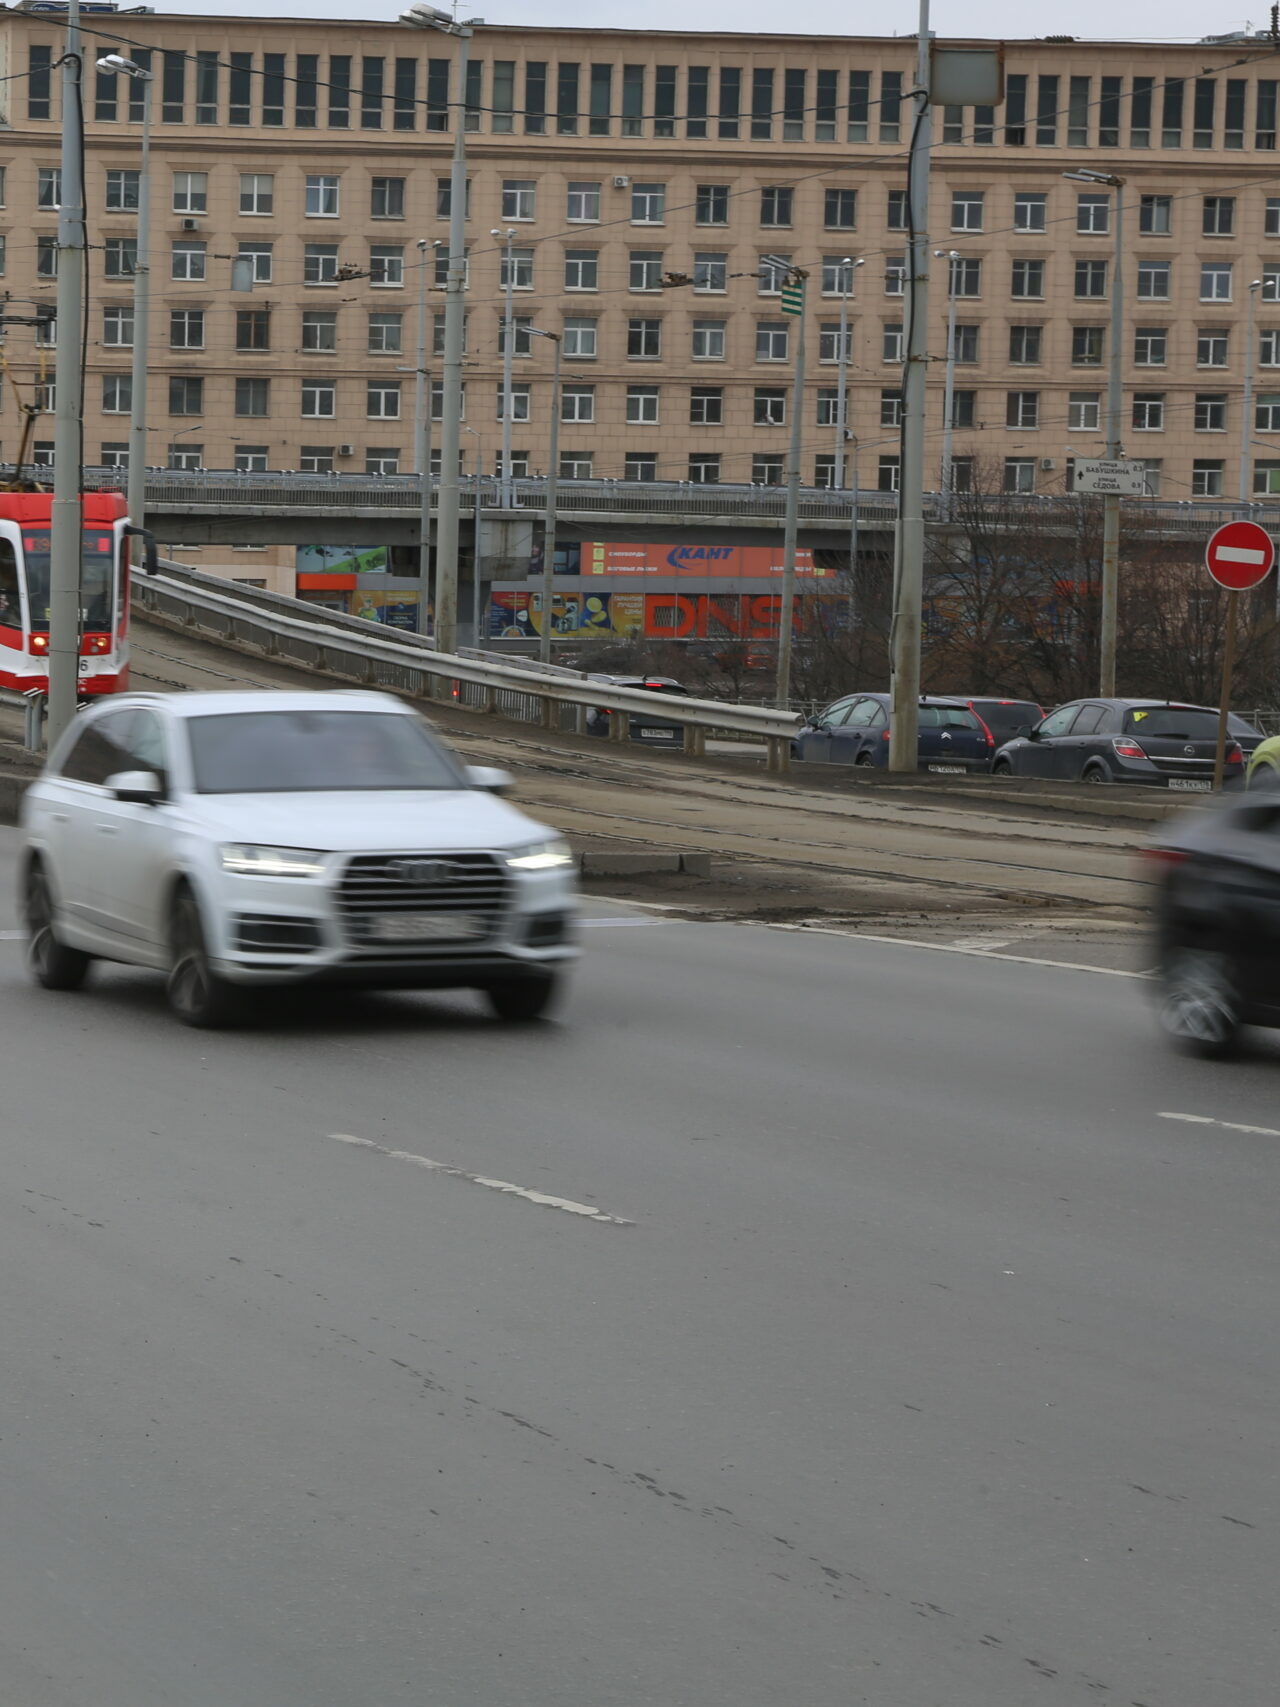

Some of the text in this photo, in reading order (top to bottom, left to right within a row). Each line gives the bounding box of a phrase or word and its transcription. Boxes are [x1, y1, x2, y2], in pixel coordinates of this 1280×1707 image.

[1086, 467, 1129, 475] БАБУШКИНА
[677, 547, 734, 560] КАНТ
[645, 595, 803, 638] DNS
